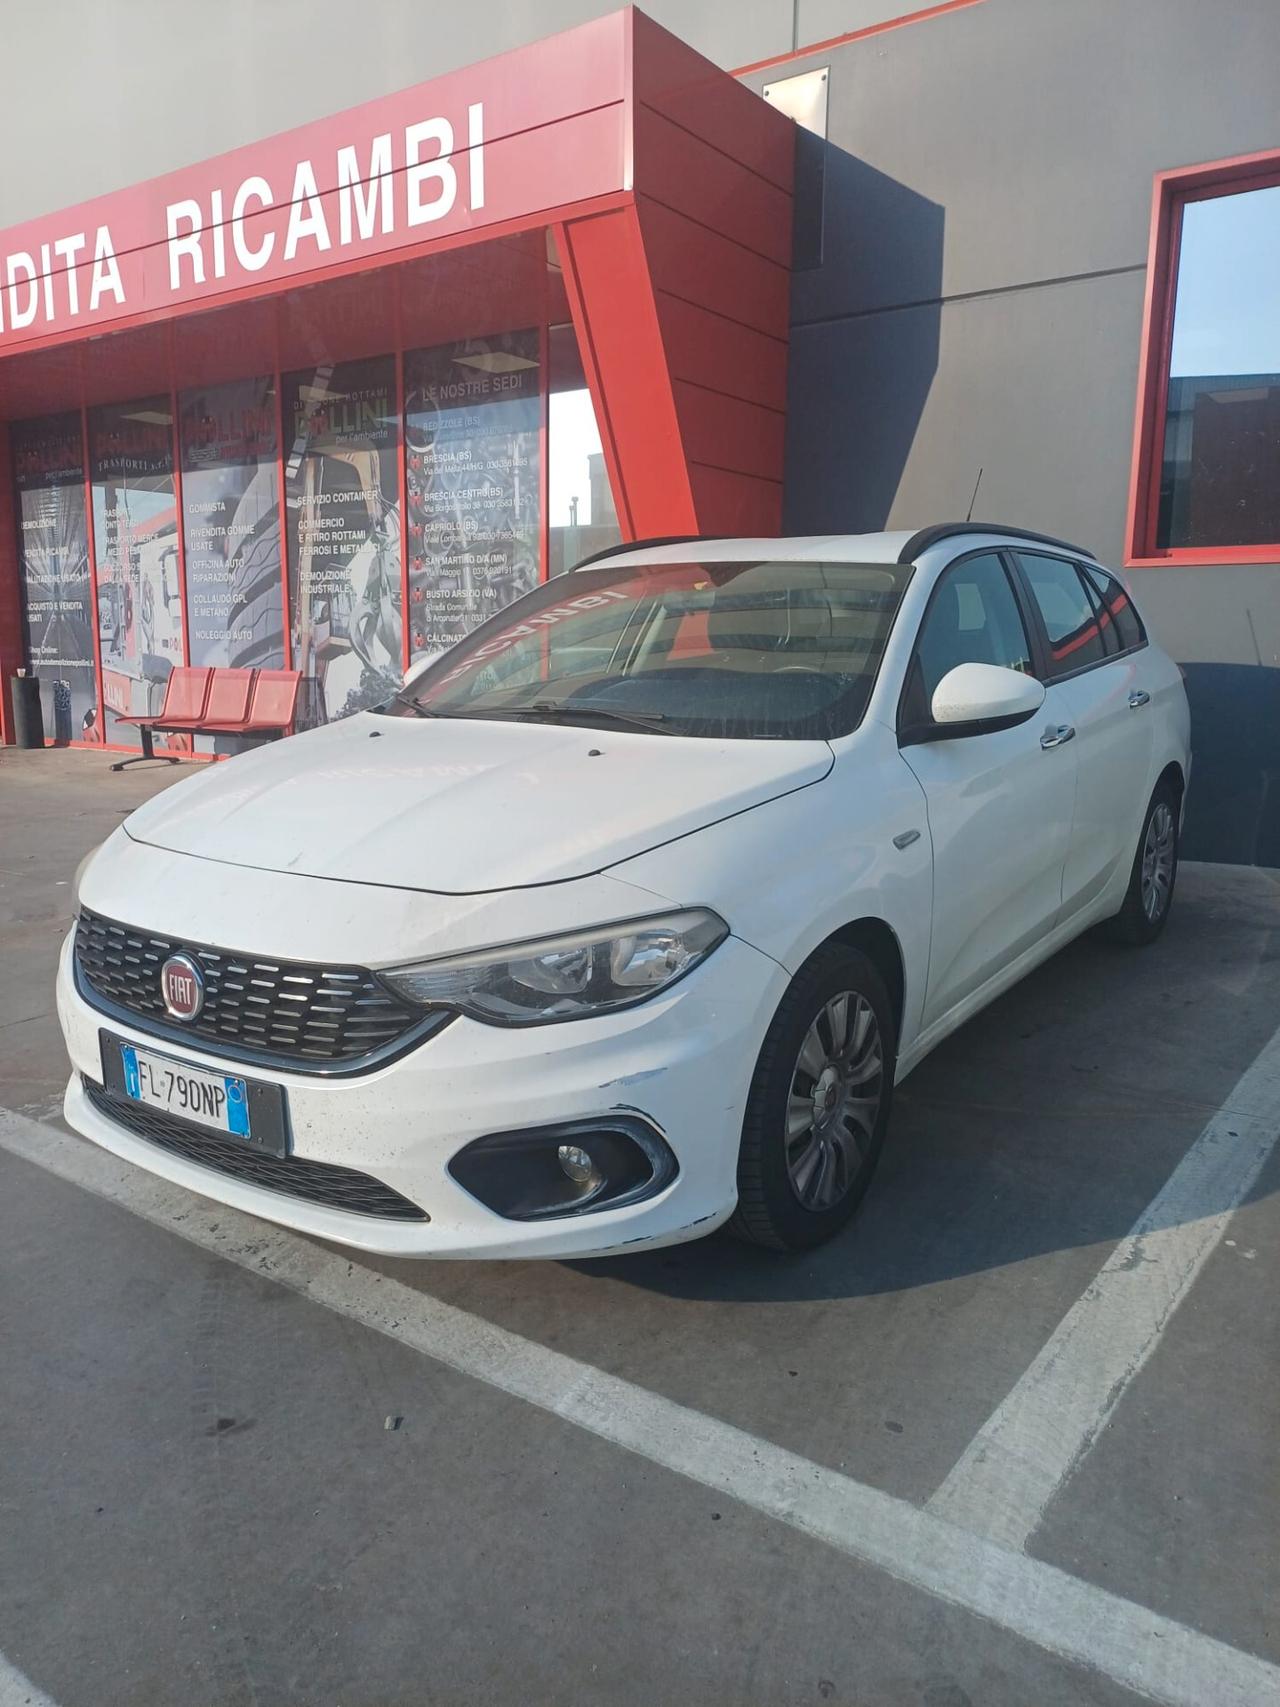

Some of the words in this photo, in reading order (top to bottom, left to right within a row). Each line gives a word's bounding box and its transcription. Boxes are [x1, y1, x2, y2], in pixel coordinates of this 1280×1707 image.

[166, 102, 486, 291] RICAMBI
[422, 386, 437, 401] LE
[440, 380, 489, 400] NOSTRE
[493, 374, 523, 391] SEDI
[423, 453, 455, 464] BRESCIA
[297, 494, 331, 505] SERVIZIO
[333, 489, 378, 503] CONTAINER
[425, 489, 456, 501] BRESCIA
[190, 502, 226, 513] GOMMISTA
[298, 518, 345, 529] COMMERCIO
[191, 527, 226, 538] RIVENDITA
[227, 524, 255, 535] GOMME
[299, 534, 304, 543] E
[332, 530, 366, 541] ROTTAMI
[191, 541, 213, 551] USATE
[300, 545, 331, 556] FERROSI
[333, 545, 338, 554] E
[193, 559, 224, 570] OFFICINA
[225, 558, 244, 568] AUTO
[300, 570, 352, 581] DEMOLIZIONE
[301, 583, 351, 594] INDUSTRIALE
[233, 593, 247, 604] GPL
[426, 590, 450, 599] BUSTO
[194, 608, 199, 617] E
[233, 629, 252, 640] AUTO
[169, 974, 192, 1006] FIAT
